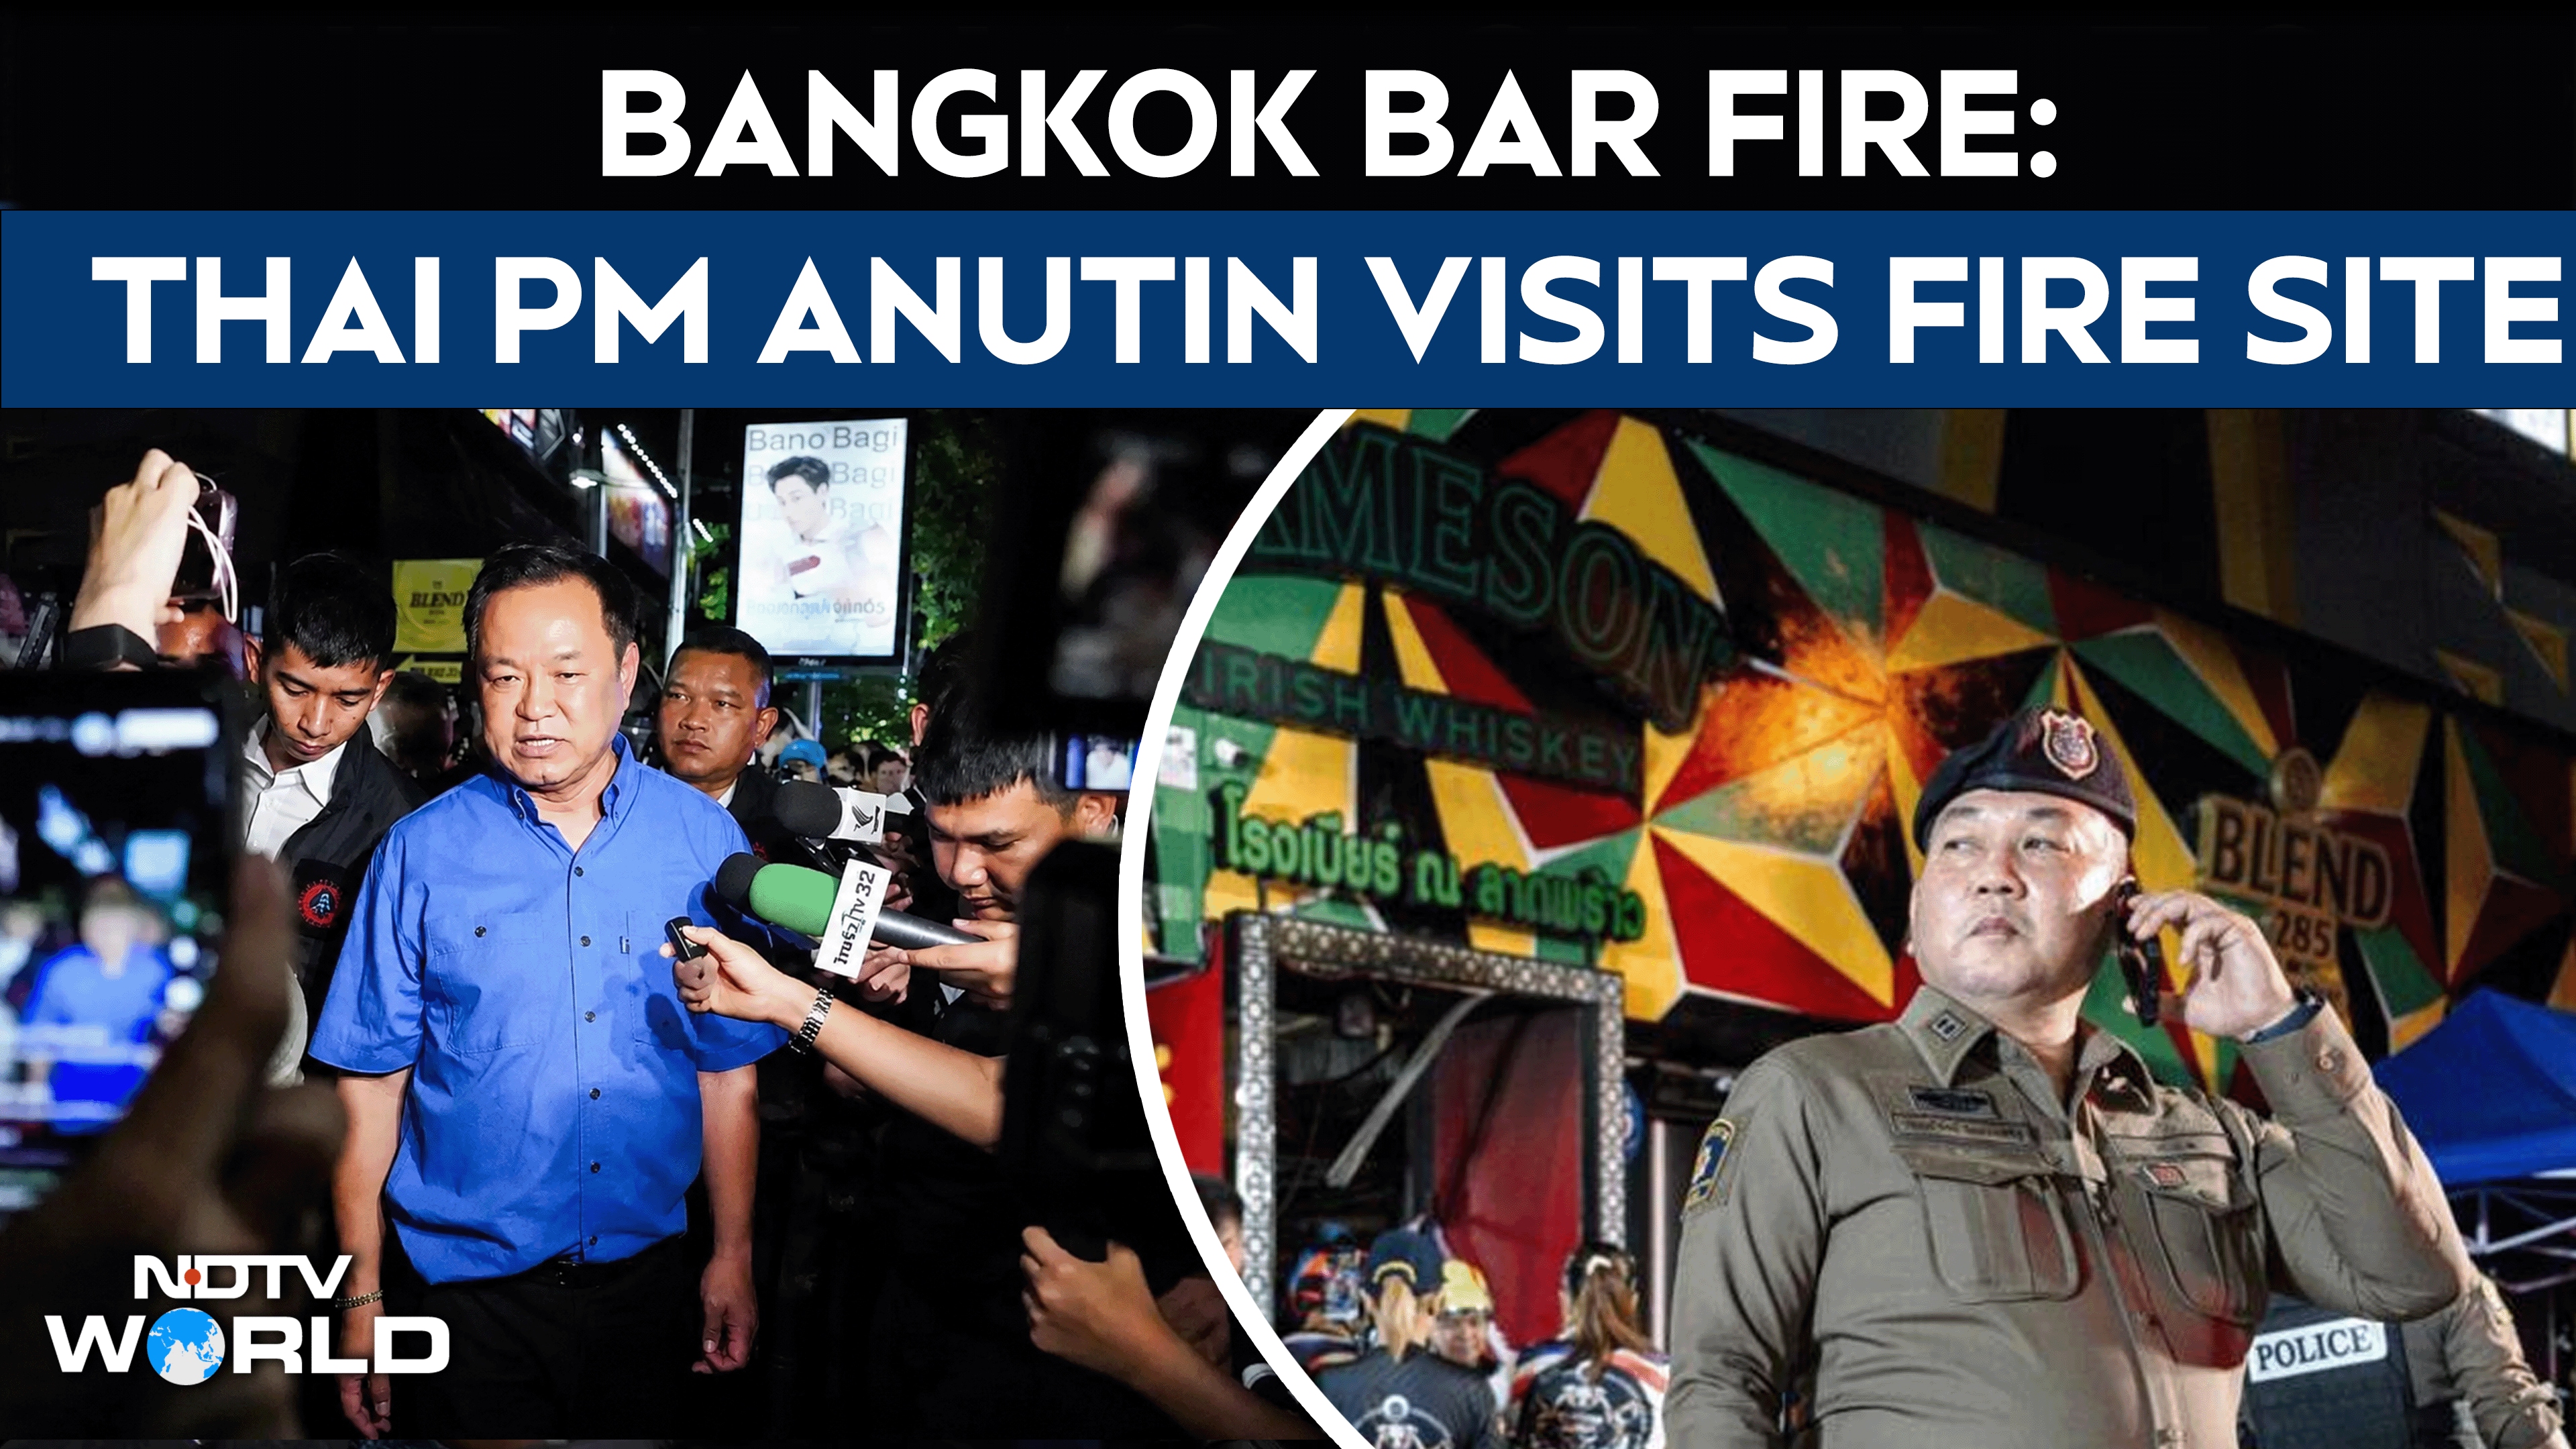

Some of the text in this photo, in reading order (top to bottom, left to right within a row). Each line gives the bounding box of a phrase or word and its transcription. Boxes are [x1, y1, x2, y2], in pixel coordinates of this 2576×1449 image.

[749, 425, 898, 452] Bano Bagi
[831, 461, 895, 489] Bagi
[410, 590, 465, 608] BLEND
[1204, 645, 1635, 786] IRISH WHISKEY
[2214, 806, 2387, 920] BLEND
[855, 870, 875, 897] 32
[2276, 910, 2332, 957] 285
[2255, 1324, 2373, 1371] POLICE
